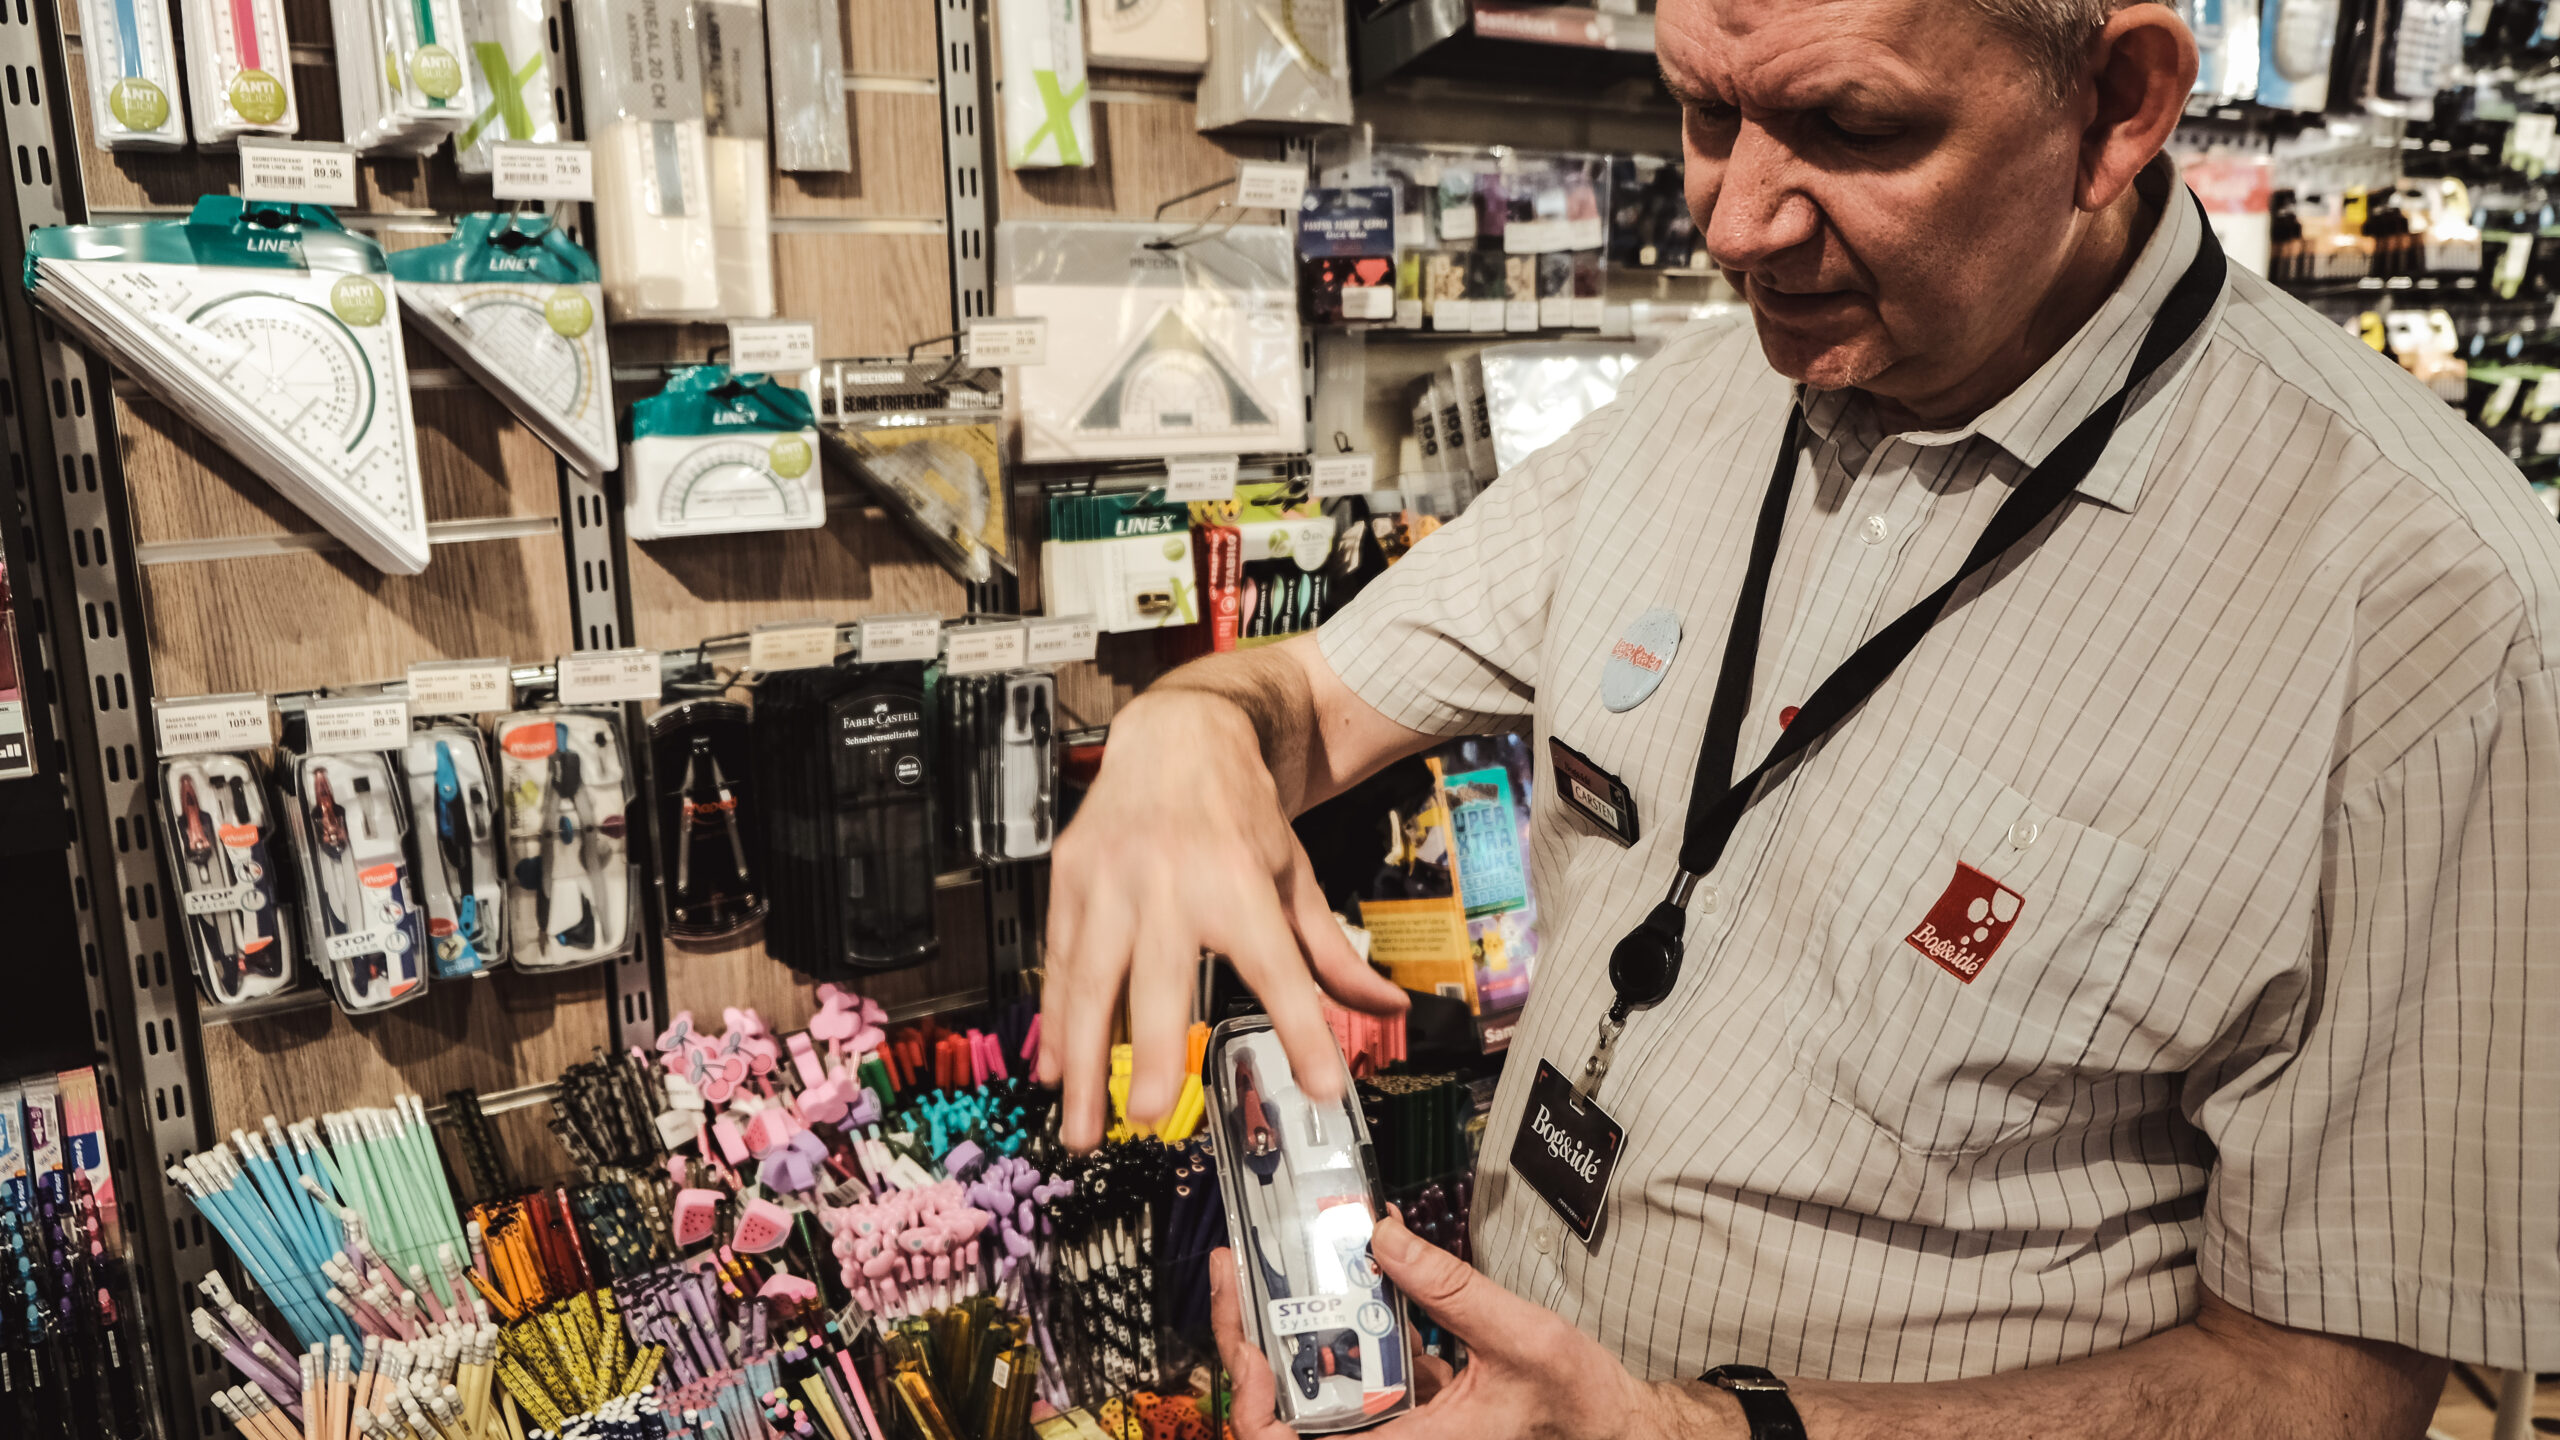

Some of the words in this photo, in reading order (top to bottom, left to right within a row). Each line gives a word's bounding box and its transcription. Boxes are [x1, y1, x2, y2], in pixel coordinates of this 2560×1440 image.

[642, 0, 660, 50] INEAL
[420, 55, 452, 69] ANTI
[650, 57, 664, 80] 20
[120, 87, 158, 102] ANTI
[238, 81, 275, 95] ANTI
[652, 83, 667, 110] CM
[313, 167, 342, 180] 89.95
[556, 163, 581, 175] 79.95
[247, 238, 302, 253] LINEX
[488, 257, 538, 272] LINEX
[339, 284, 375, 298] ANTI
[846, 371, 905, 385] PRECISION
[712, 409, 758, 426] LINEX
[1115, 514, 1174, 537] LINEX
[1223, 533, 1238, 595] STABILO
[623, 663, 653, 674] 149.95
[470, 680, 497, 691] 59.95
[228, 716, 263, 730] 109.95
[373, 717, 401, 728] 89.95
[843, 712, 920, 729] FABER-CASTELL
[845, 728, 920, 746] Schnellverstellzirkel
[1575, 785, 1616, 823] CARSTEN
[1453, 805, 1508, 833] UPER
[1457, 827, 1512, 857] XTRA
[191, 890, 233, 903] STOP
[334, 932, 376, 948] STOP
[1912, 922, 1985, 975] Bog&idé
[1531, 1103, 1602, 1184] Bog&idé
[1279, 1298, 1343, 1317] STOP
